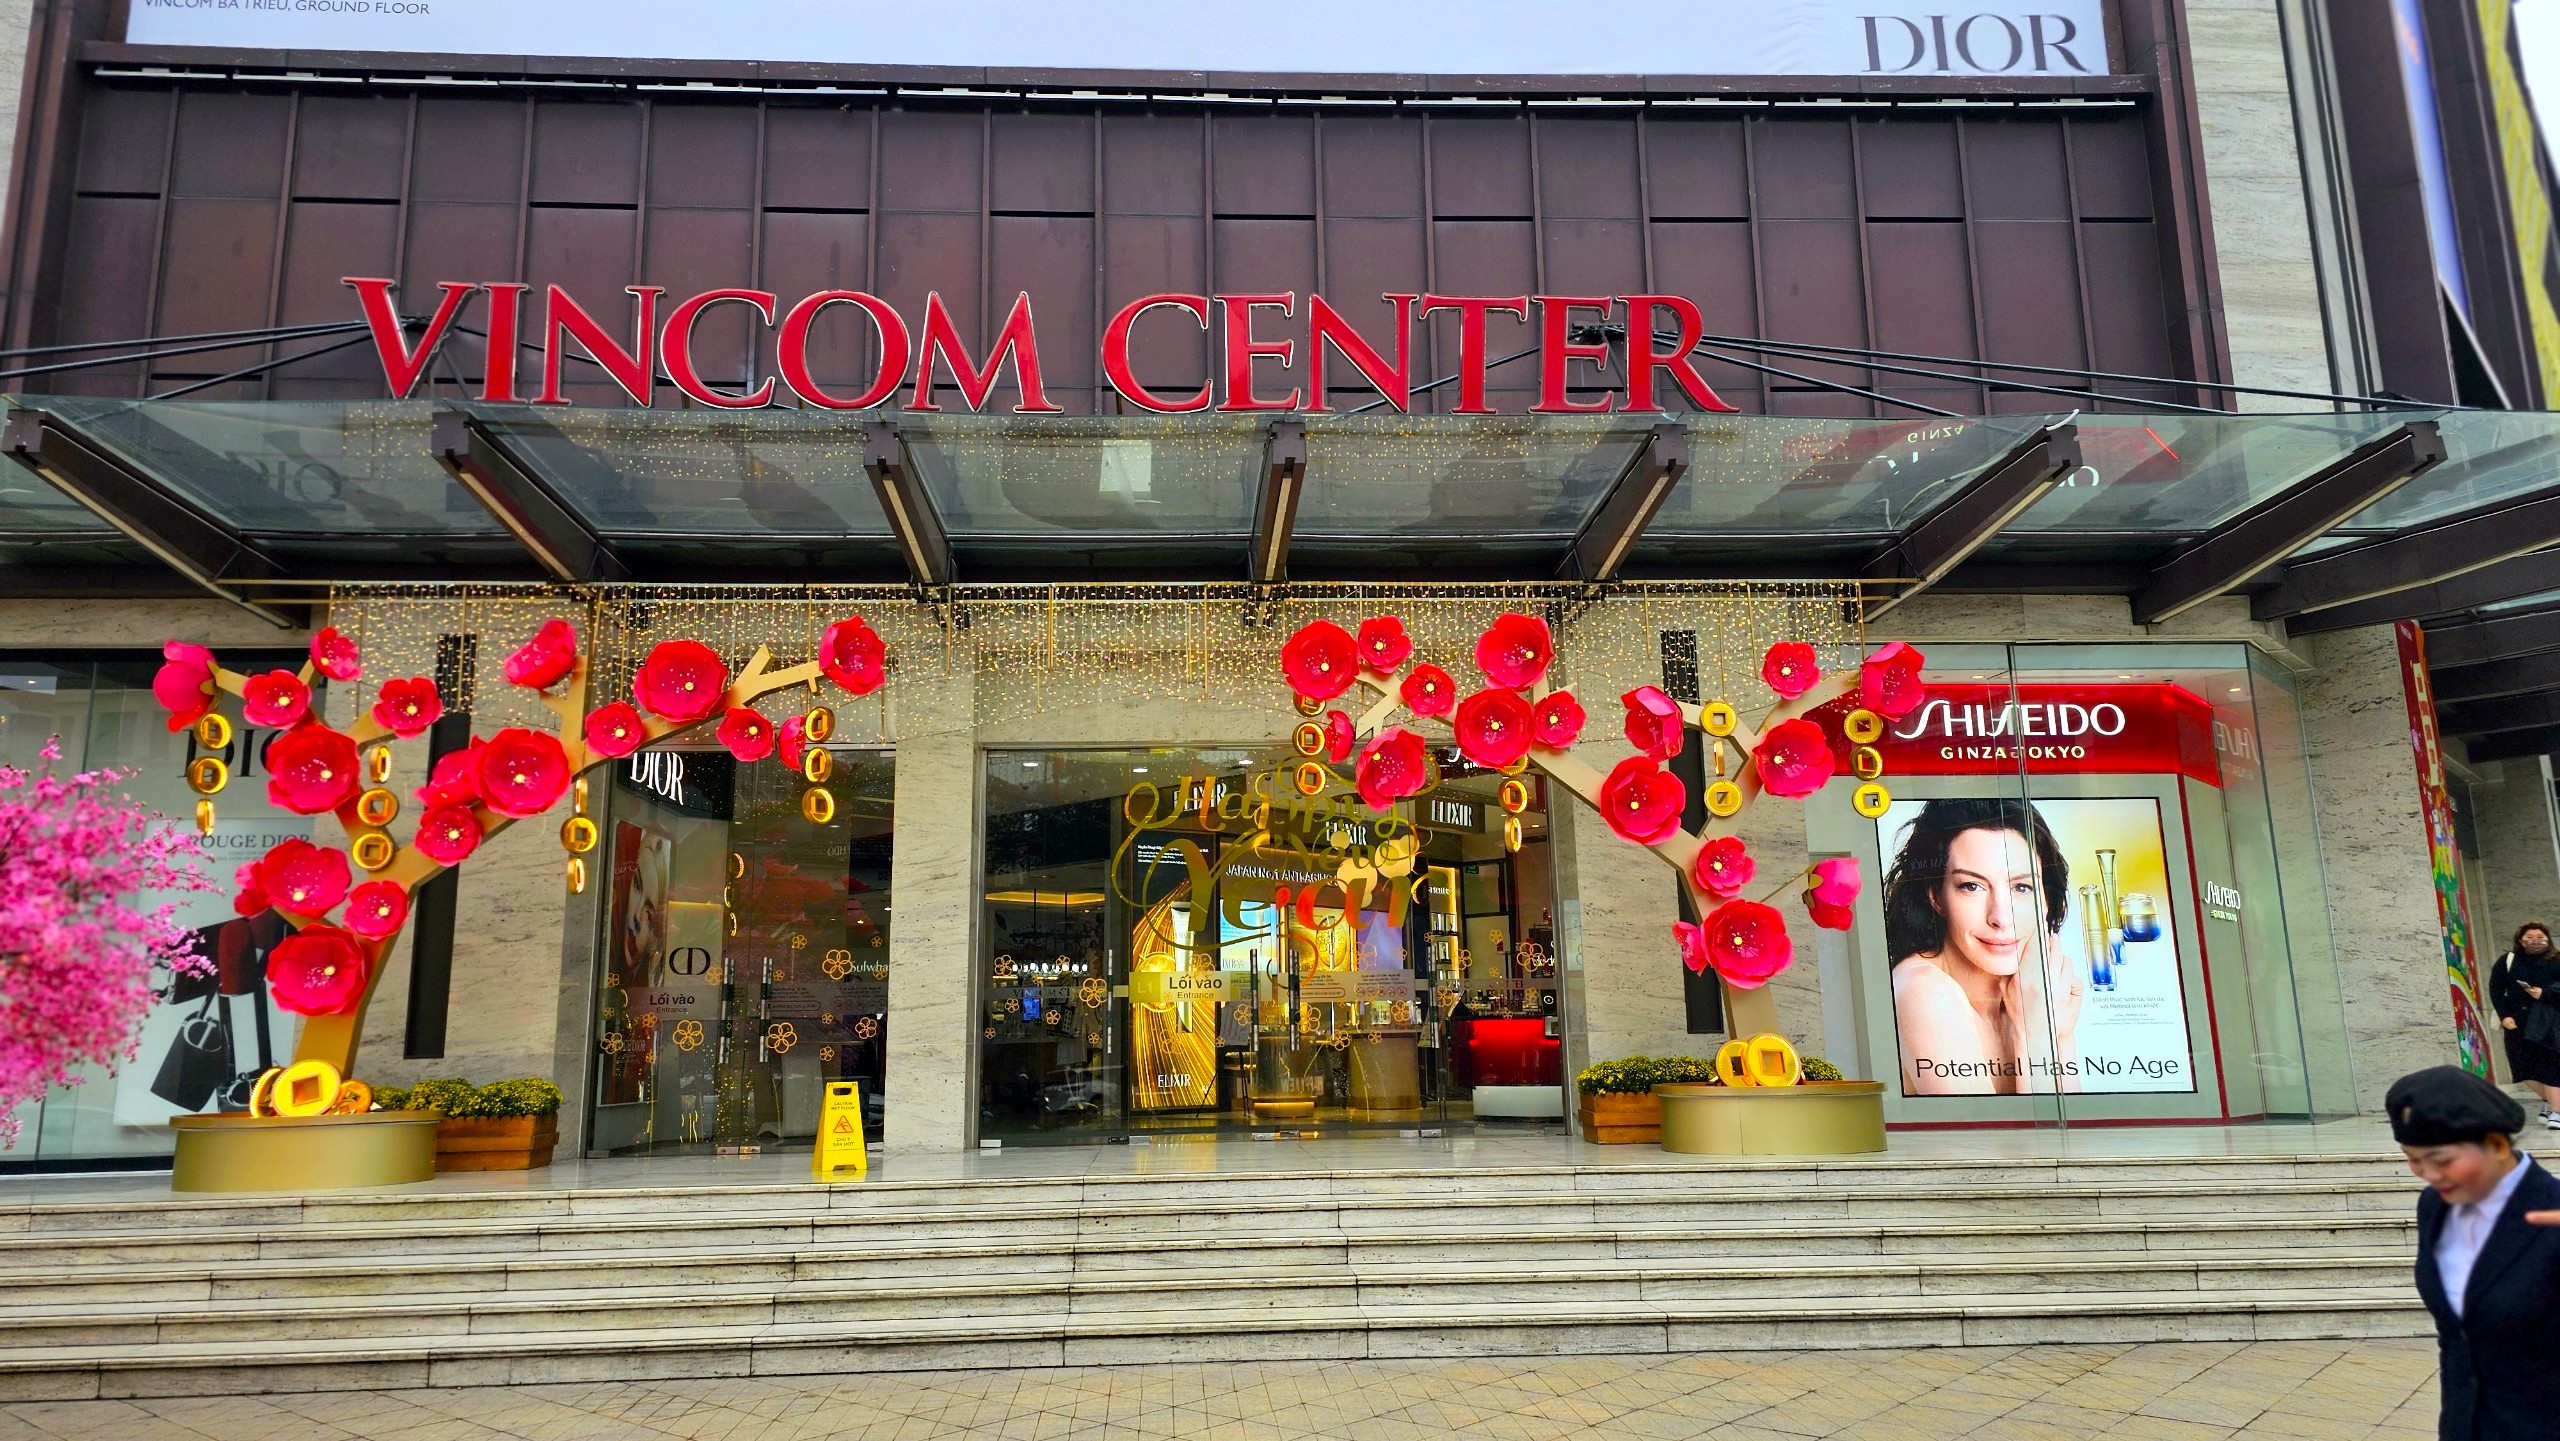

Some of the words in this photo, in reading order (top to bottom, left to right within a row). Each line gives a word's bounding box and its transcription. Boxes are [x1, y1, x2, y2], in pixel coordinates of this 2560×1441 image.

[296, 0, 370, 13] GROUND
[375, 2, 430, 14] FLOOR
[1855, 13, 2092, 74] DIOR
[341, 276, 1064, 415] VINCOM
[1101, 290, 1742, 415] CENTER
[1895, 699, 2126, 739] SHISEIDO
[1941, 746, 2007, 760] GINZA
[630, 752, 684, 806] DIOR
[1431, 799, 1473, 827] ELIXIR
[1226, 863, 1257, 878] JAPAN
[1169, 973, 1192, 989] Lối
[650, 992, 670, 1006] Lối
[672, 994, 695, 1005] vào
[1177, 991, 1215, 999] Entrance
[656, 1006, 688, 1014] Entrance
[1915, 1056, 2023, 1078] Potential
[2029, 1057, 2079, 1077] Has
[2085, 1056, 2122, 1076] No
[2128, 1055, 2179, 1079] Age
[1158, 1073, 1191, 1088] ELIXIR
